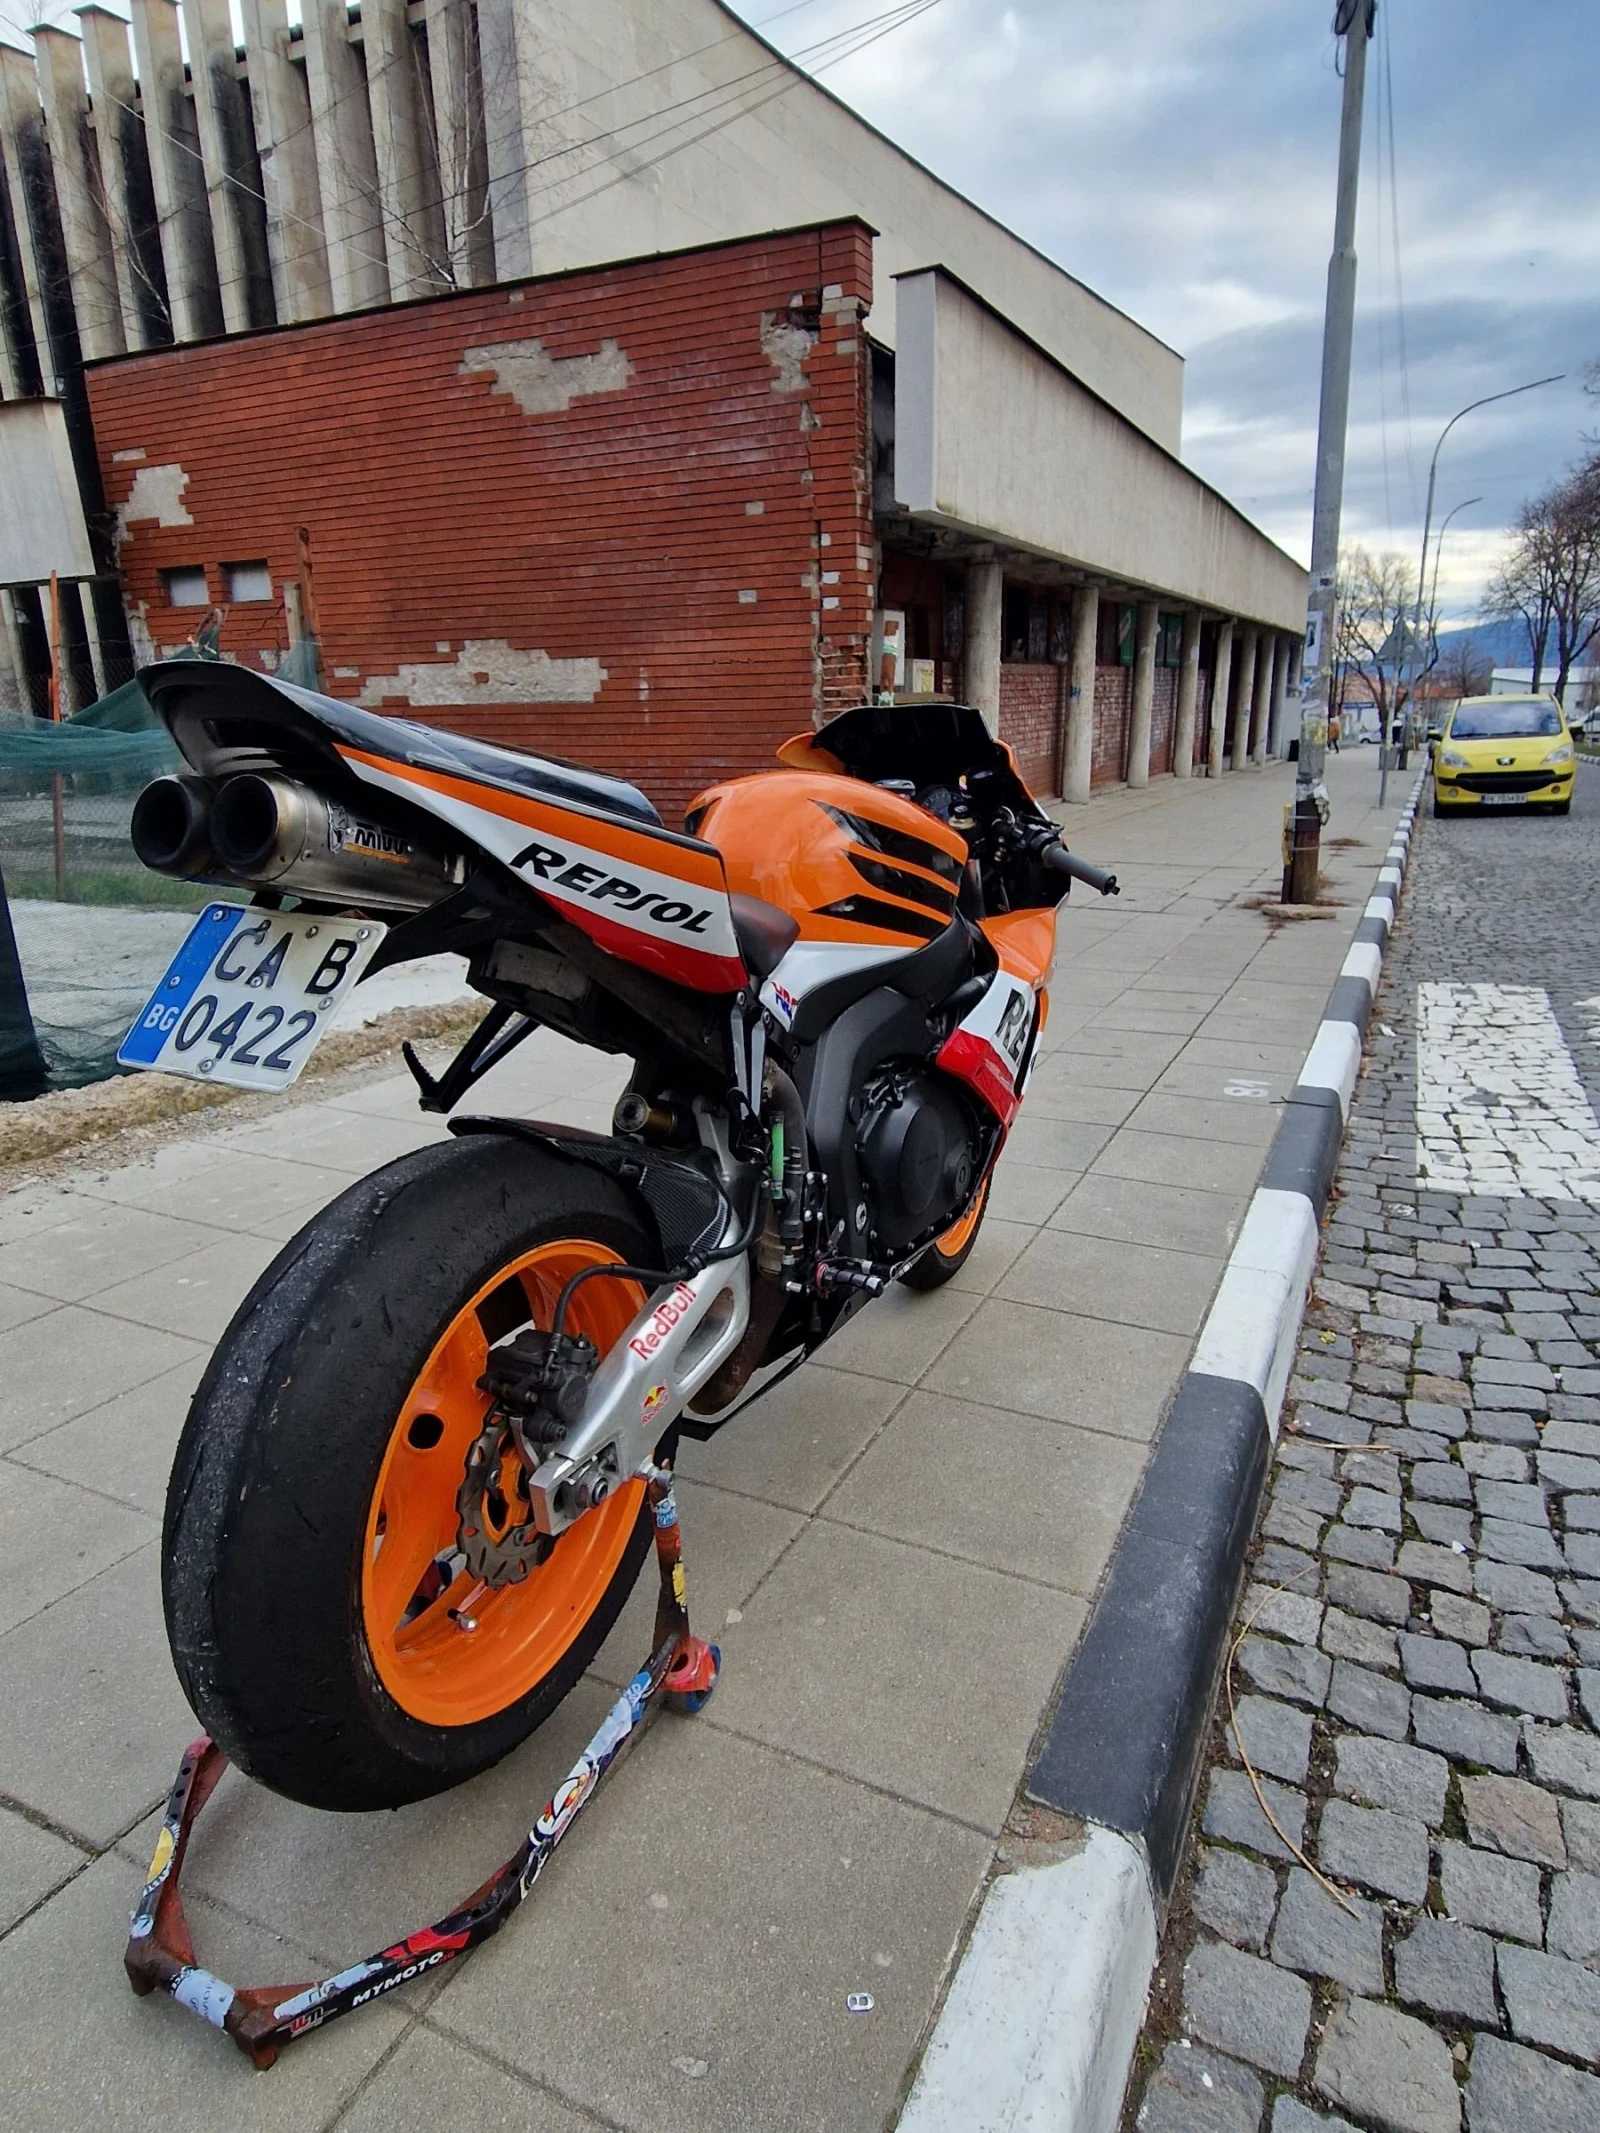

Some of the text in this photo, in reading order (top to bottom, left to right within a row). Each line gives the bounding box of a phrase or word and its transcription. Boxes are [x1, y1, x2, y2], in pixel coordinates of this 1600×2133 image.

[509, 842, 714, 933] REPSOL
[214, 927, 358, 994] CA B
[143, 1003, 180, 1031] BG
[174, 994, 317, 1070] 0422
[995, 988, 1031, 1069] RE
